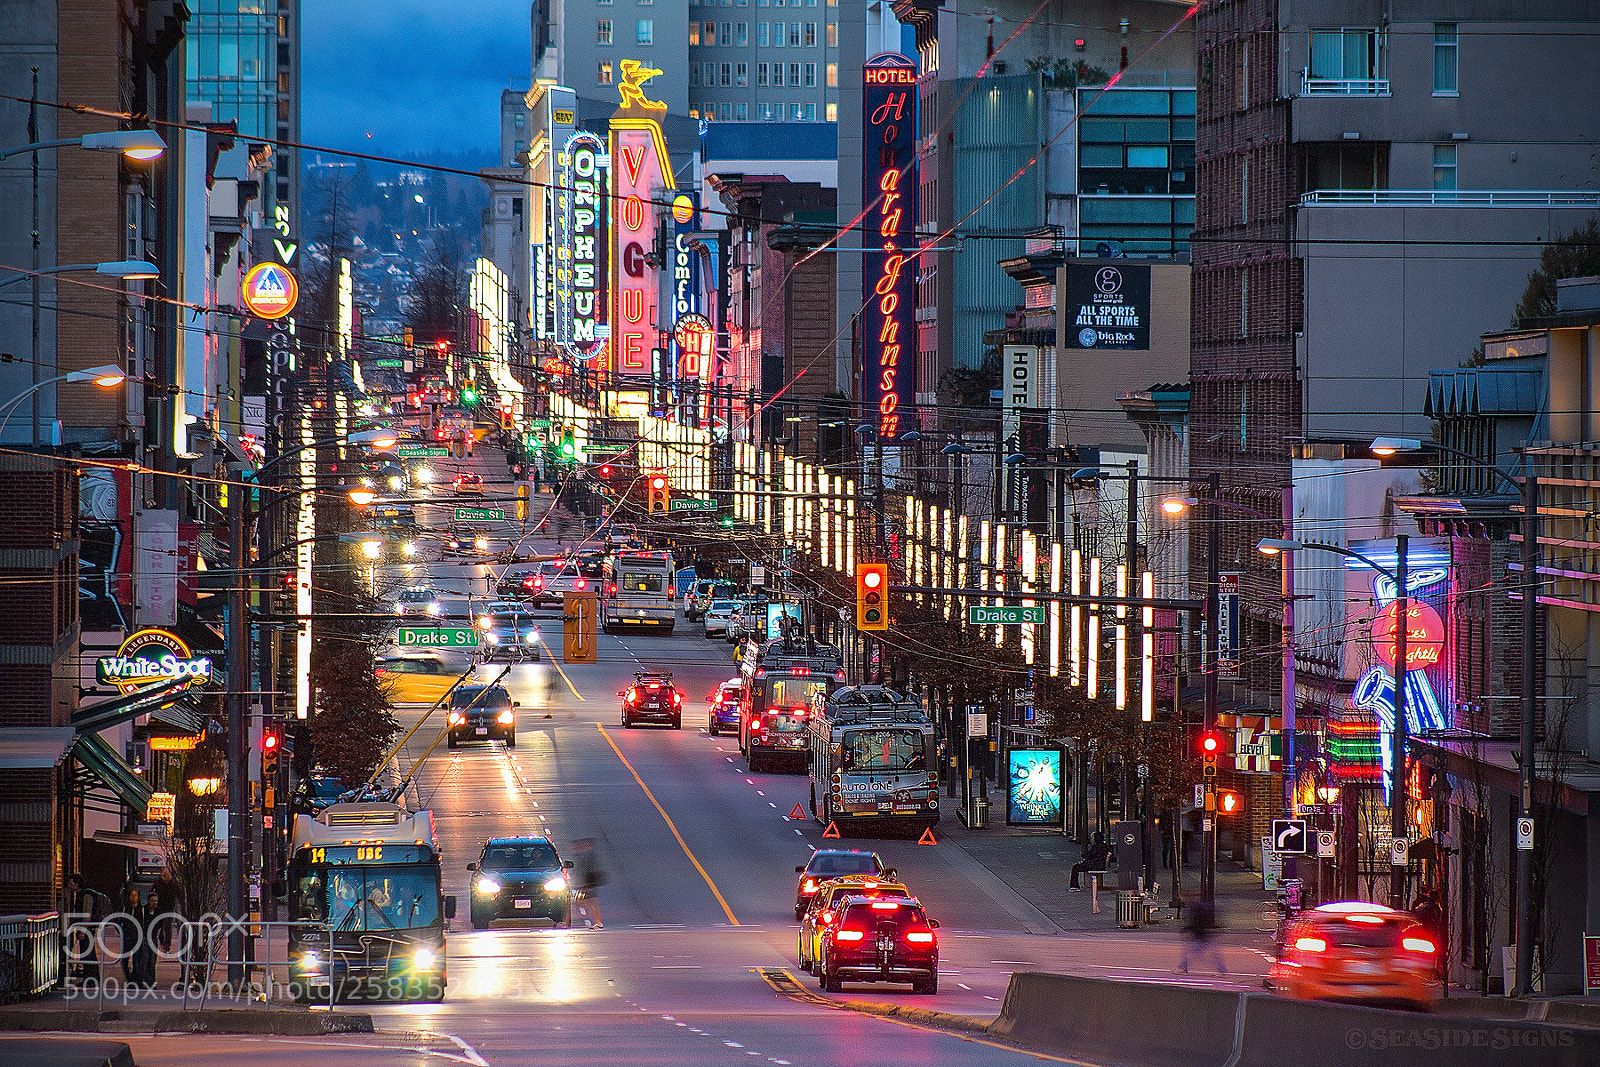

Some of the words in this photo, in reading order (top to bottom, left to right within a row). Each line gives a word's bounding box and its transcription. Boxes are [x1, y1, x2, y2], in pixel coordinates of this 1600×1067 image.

[866, 69, 915, 84] HOTEL
[871, 91, 906, 237] Howard
[573, 148, 596, 342] ORPHEUM
[620, 145, 646, 369] VOGUE
[1080, 305, 1097, 316] ALL
[1099, 305, 1136, 317] SPORTS
[1076, 315, 1093, 325] ALL
[1095, 316, 1113, 326] THE
[1115, 316, 1139, 327] TIME
[1115, 332, 1136, 341] Rock
[876, 253, 904, 438] Johnson
[429, 449, 446, 458] Signs
[675, 500, 699, 510] Davie
[702, 500, 713, 510] St
[458, 510, 486, 520] Davie
[488, 511, 500, 520] St
[976, 609, 1017, 622] Drake
[1021, 609, 1038, 622] St
[126, 634, 181, 653] LEGENDARY
[404, 630, 449, 644] Drake
[455, 630, 472, 644] St
[1389, 645, 1440, 663] ghtly
[311, 847, 326, 864] 14
[356, 847, 383, 860] UBC
